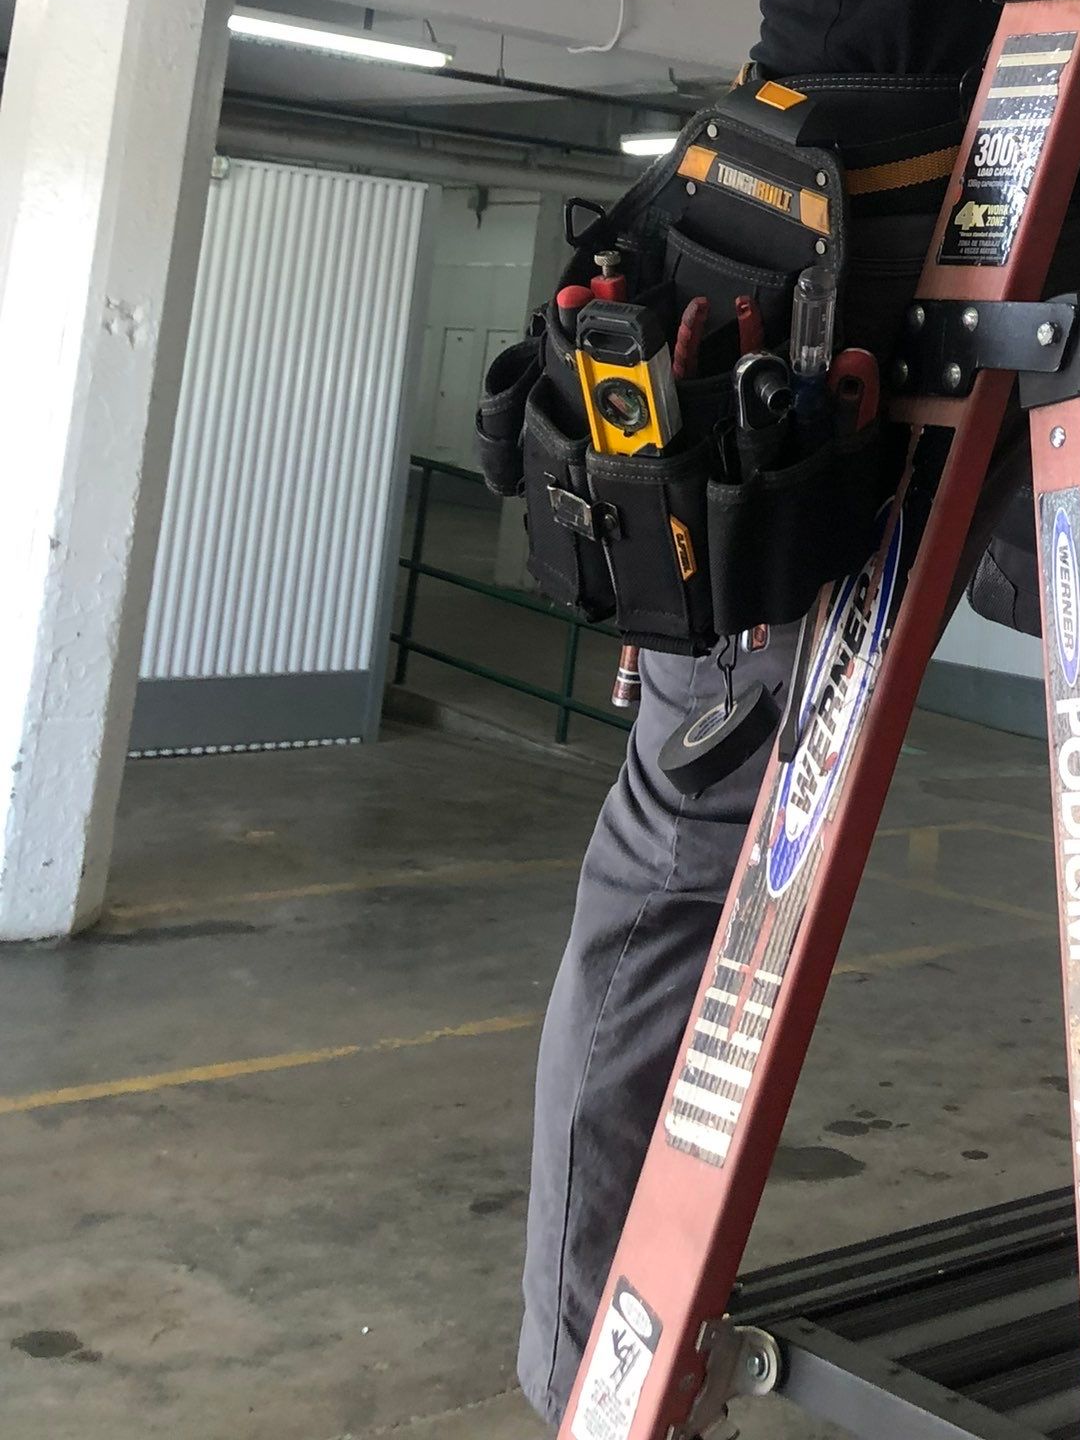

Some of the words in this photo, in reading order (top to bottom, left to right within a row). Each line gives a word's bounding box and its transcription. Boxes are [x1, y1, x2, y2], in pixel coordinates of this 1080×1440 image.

[977, 167, 994, 177] LOAD
[718, 162, 793, 212] TOUGHBUILT
[987, 204, 1010, 215] WORK
[985, 216, 1005, 227] ZONE
[1059, 544, 1074, 650] WERNER
